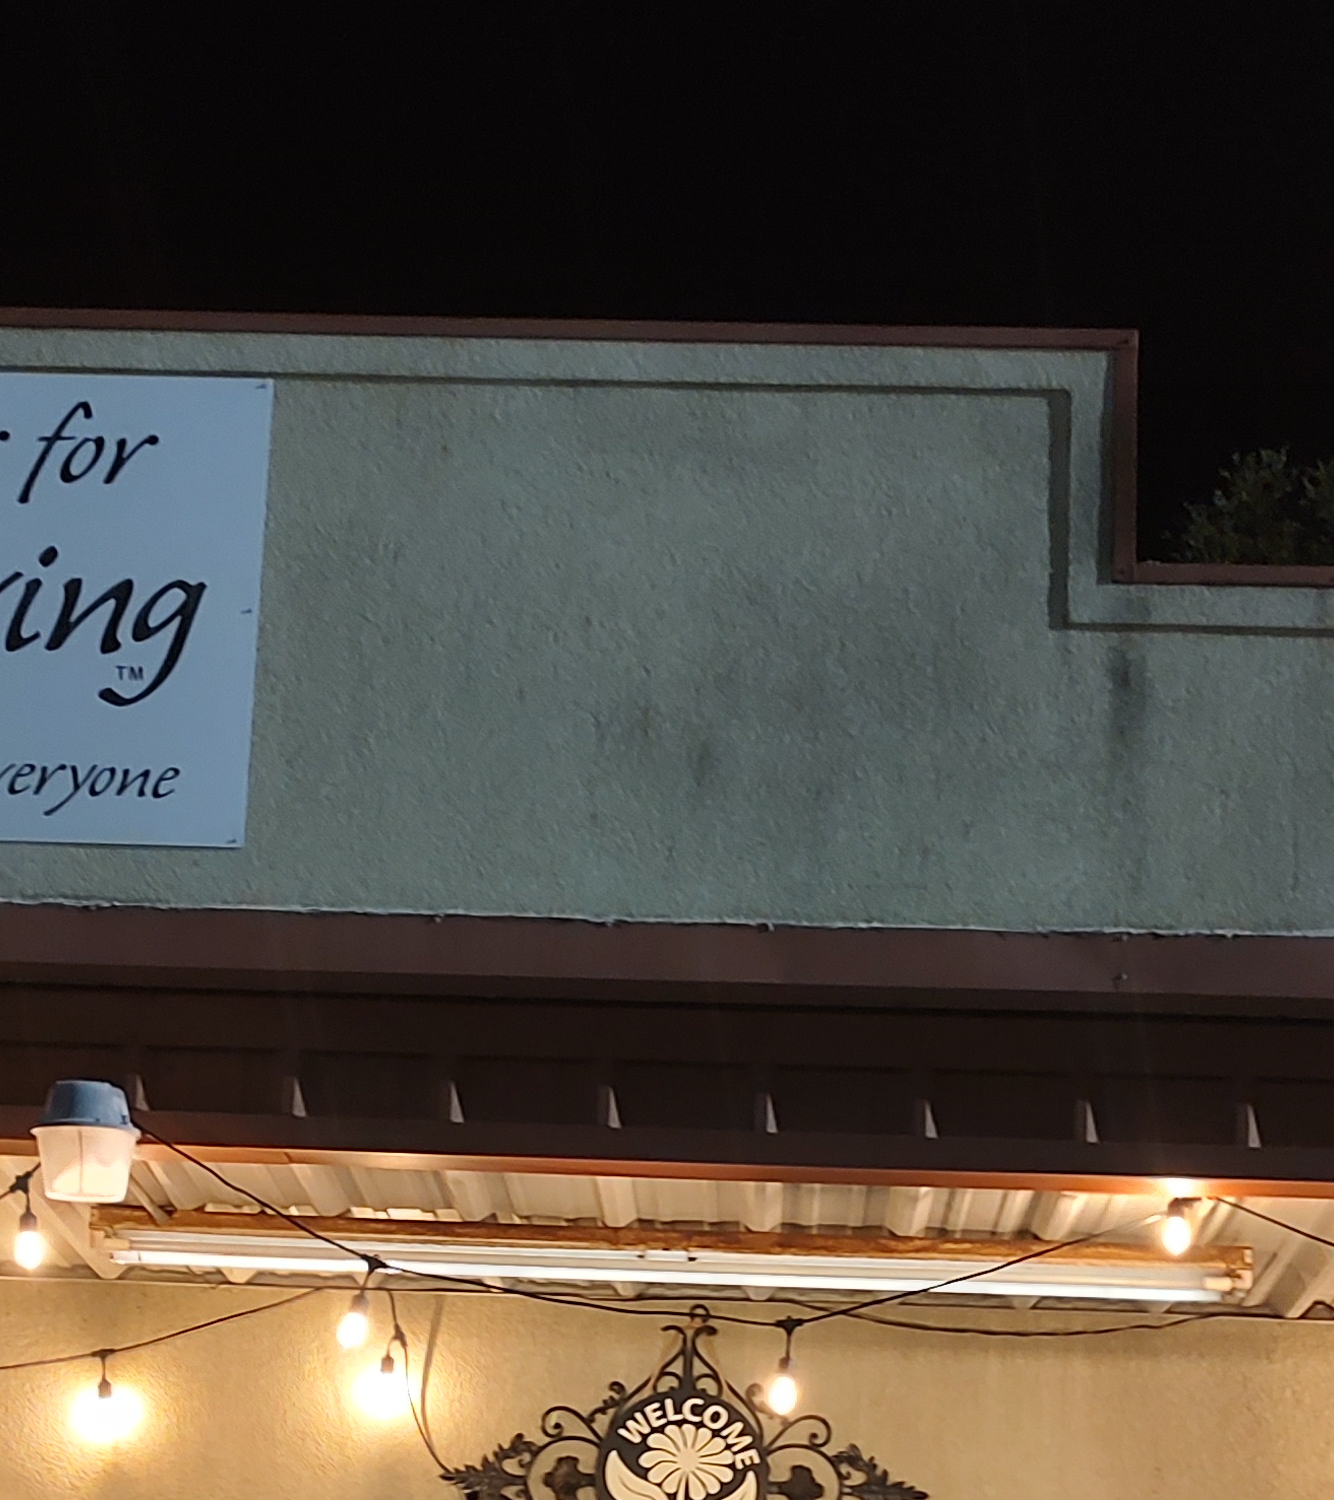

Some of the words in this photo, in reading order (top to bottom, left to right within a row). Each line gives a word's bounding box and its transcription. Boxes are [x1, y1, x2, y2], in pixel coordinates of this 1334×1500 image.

[18, 401, 159, 504] for
[115, 665, 144, 681] TM
[617, 1397, 761, 1470] WELCOME
